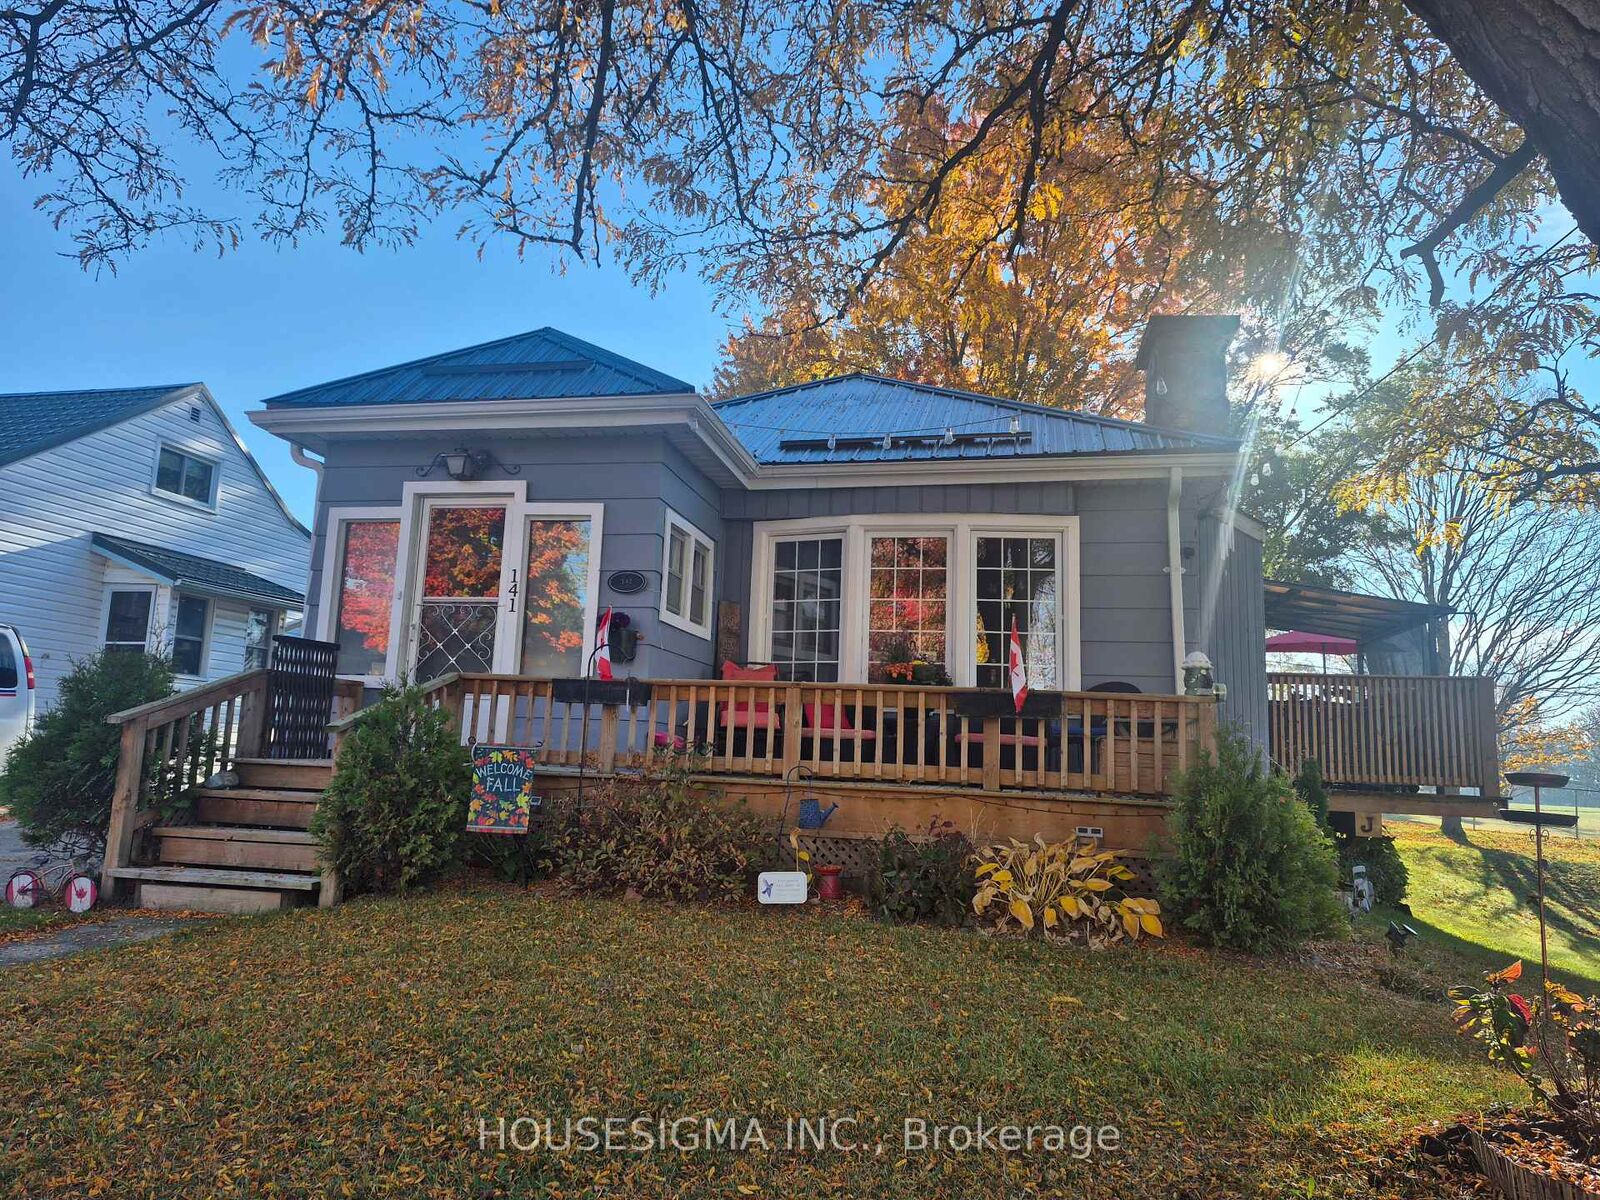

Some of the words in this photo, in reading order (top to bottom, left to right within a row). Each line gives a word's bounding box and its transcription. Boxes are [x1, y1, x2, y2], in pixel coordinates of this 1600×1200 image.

[508, 568, 518, 613] 141
[475, 762, 533, 780] WELCOME
[486, 777, 520, 792] FALL
[1360, 816, 1373, 832] J
